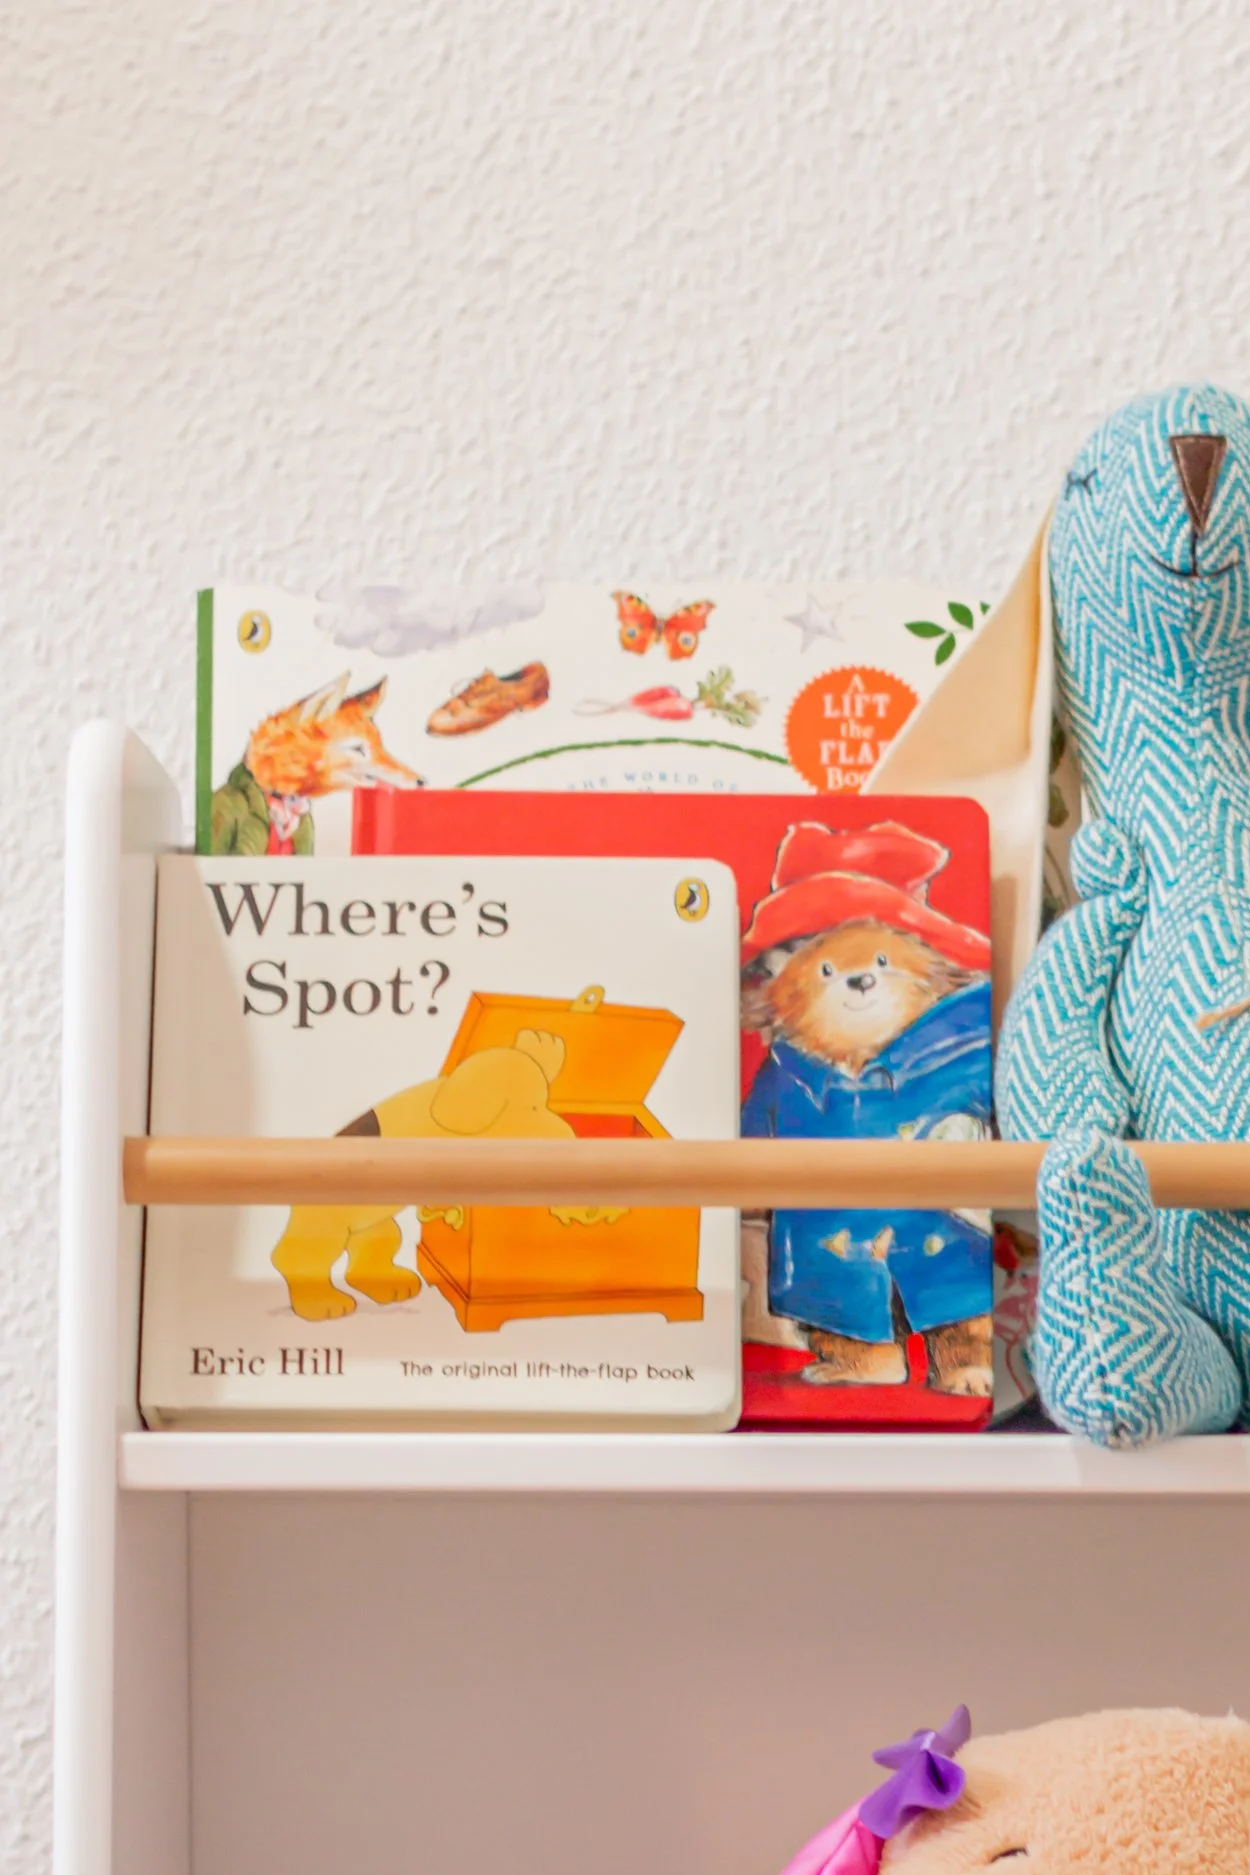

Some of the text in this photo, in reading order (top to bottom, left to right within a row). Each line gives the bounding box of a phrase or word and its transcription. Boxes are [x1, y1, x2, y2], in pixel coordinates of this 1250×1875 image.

[823, 693, 891, 718] LIFT
[840, 719, 874, 739] the
[204, 881, 510, 937] Where’s
[242, 959, 451, 1029] Spot?
[190, 1346, 344, 1376] Eric Hill
[399, 1360, 695, 1382] The original lift-the-flap book
